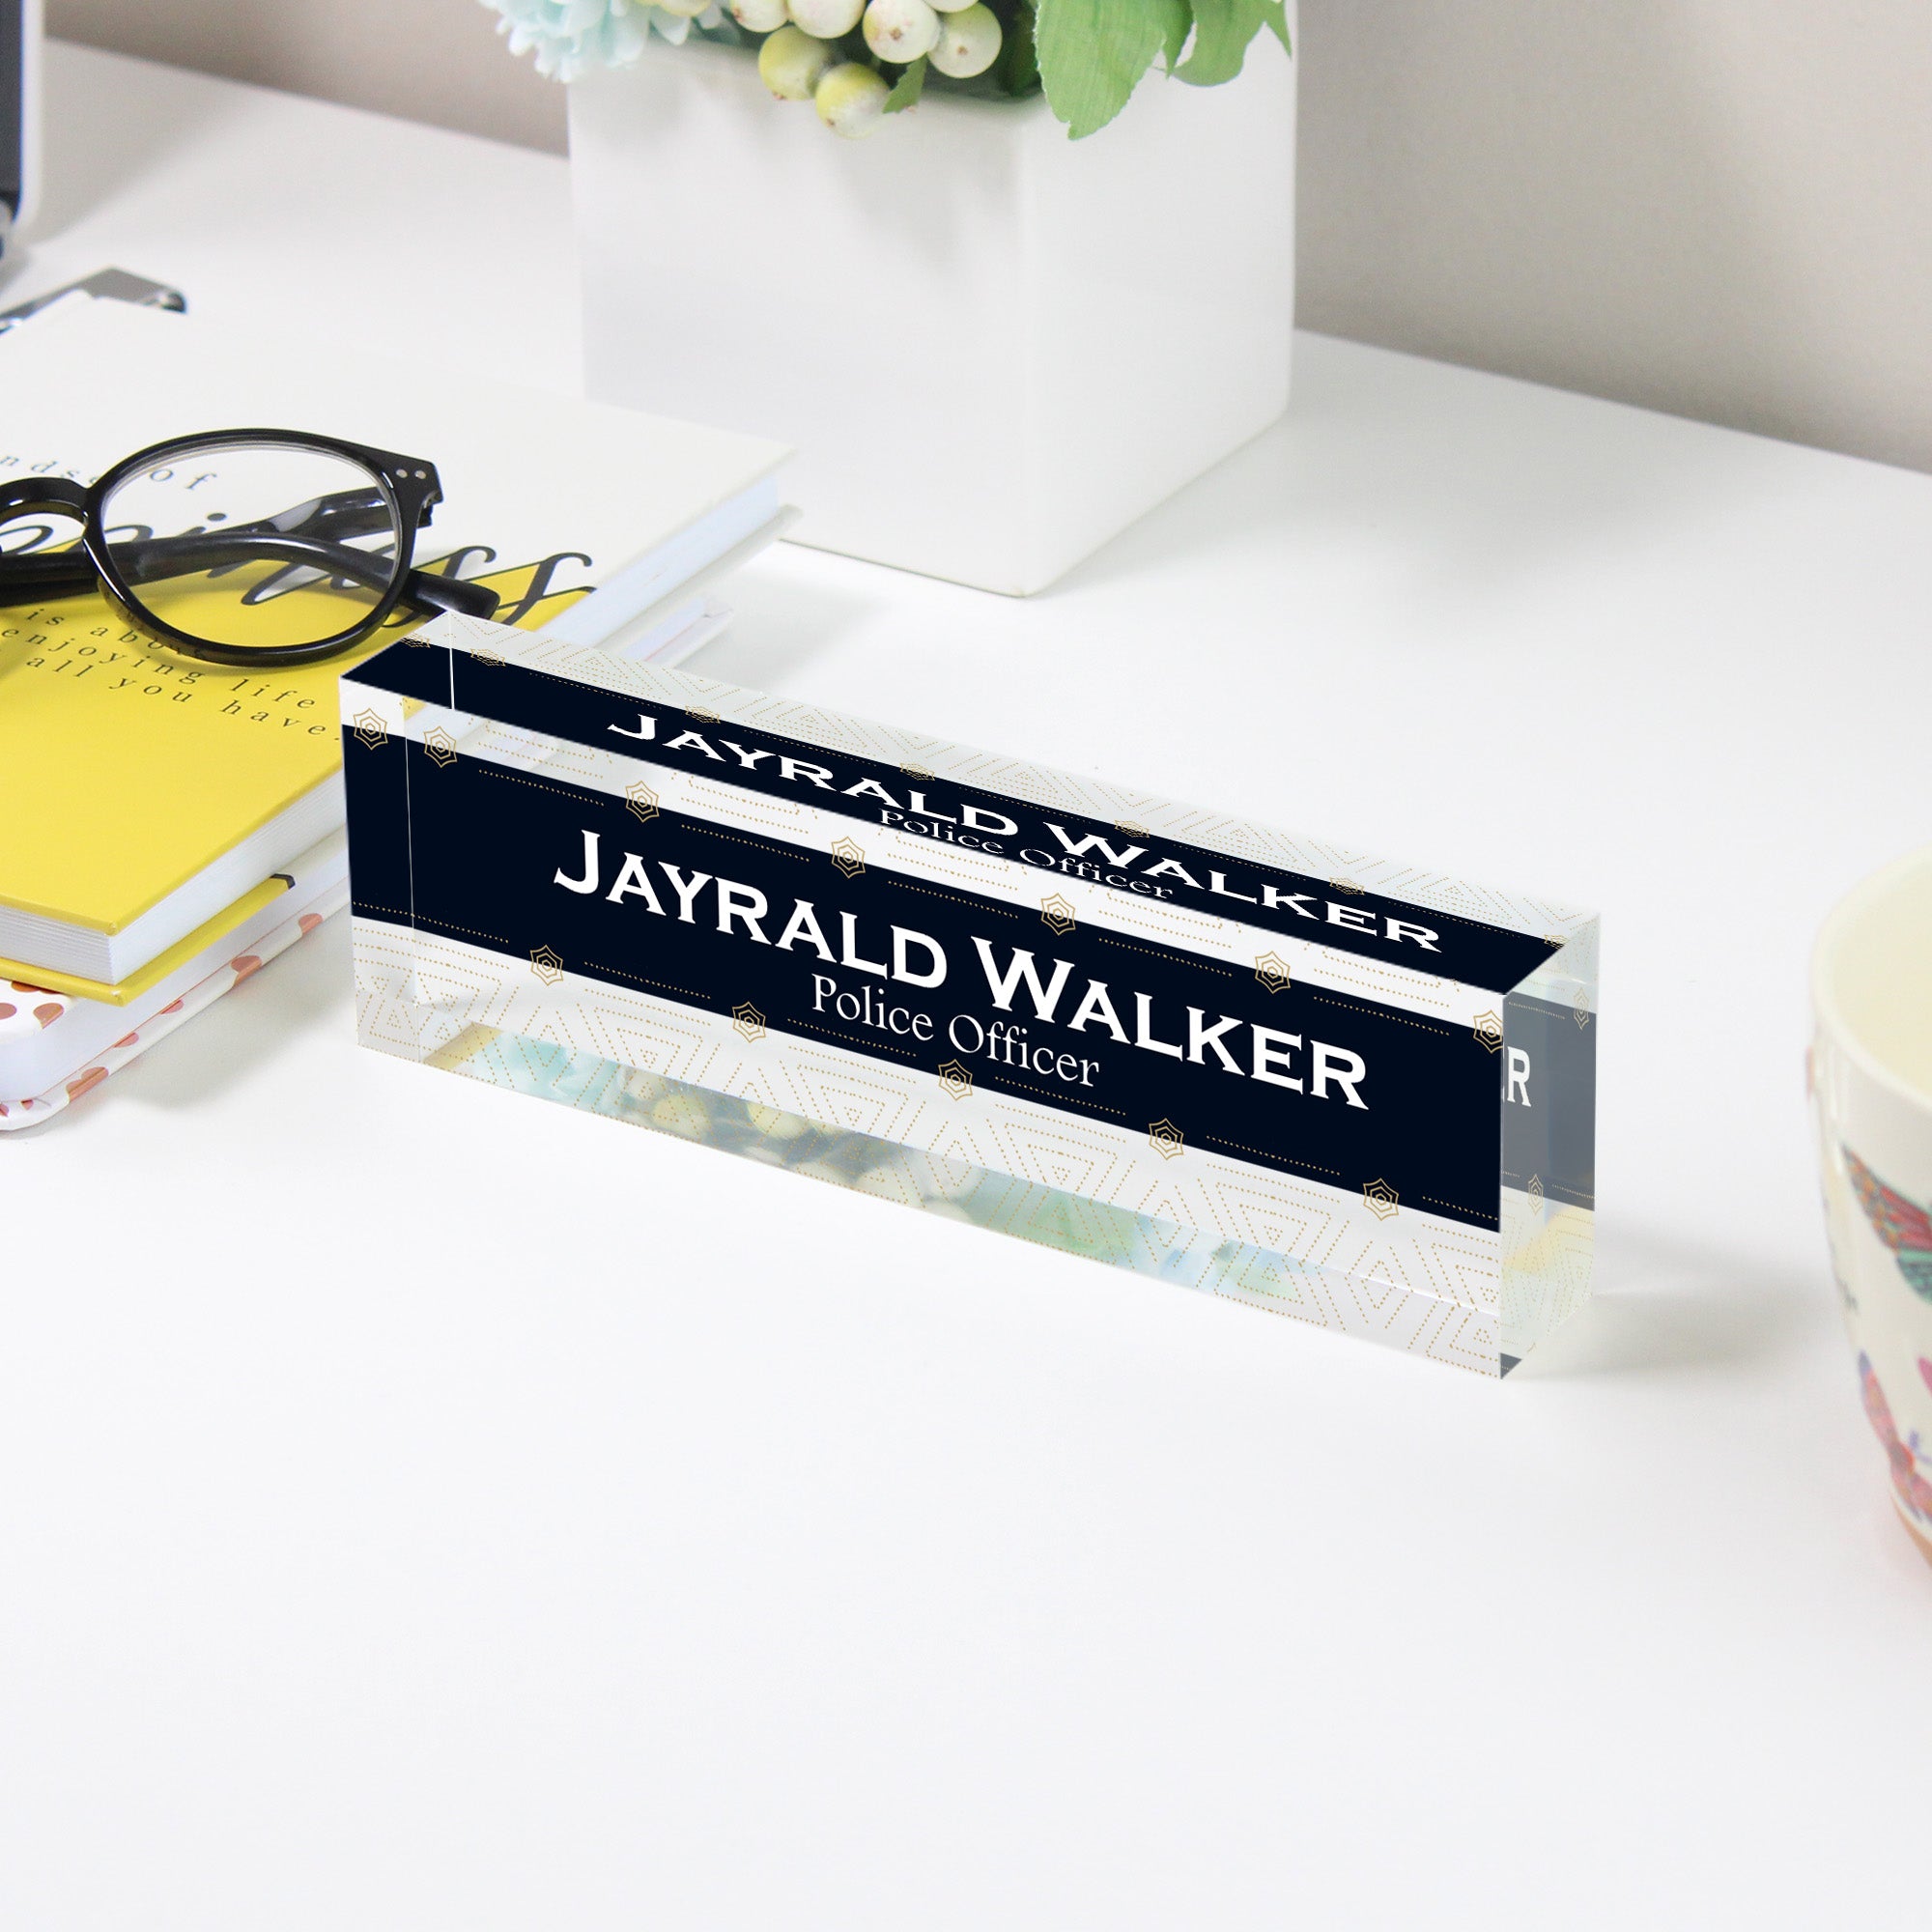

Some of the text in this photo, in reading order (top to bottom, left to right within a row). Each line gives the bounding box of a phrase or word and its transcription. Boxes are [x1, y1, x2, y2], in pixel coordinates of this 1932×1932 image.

[150, 468, 217, 491] of
[1, 628, 316, 709] enjoying life
[26, 609, 185, 656] is abo
[26, 657, 340, 741] all you have.
[608, 713, 1442, 953] JAYRALD WALKER
[880, 809, 1175, 900] Police Officer
[554, 829, 1369, 1111] JAYRALD WALKER
[811, 973, 1099, 1087] Police Officer
[1504, 1045, 1532, 1108] R
